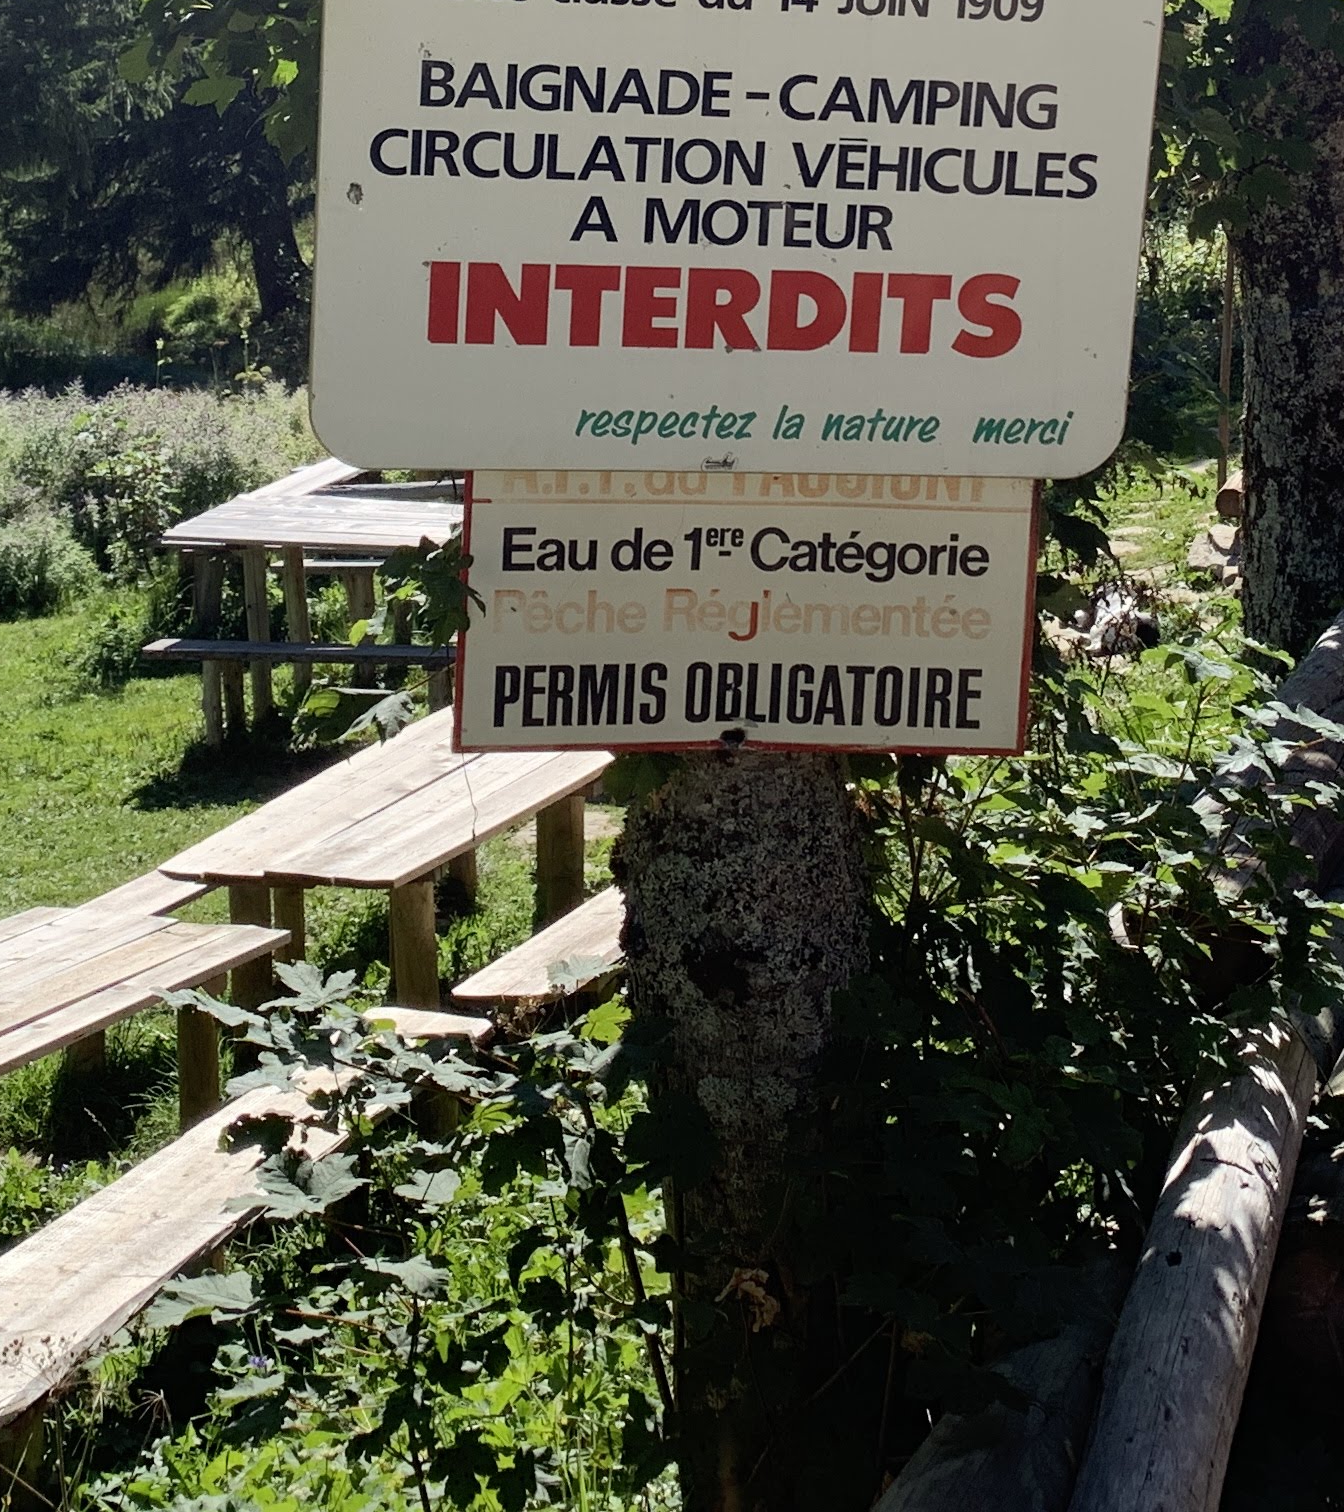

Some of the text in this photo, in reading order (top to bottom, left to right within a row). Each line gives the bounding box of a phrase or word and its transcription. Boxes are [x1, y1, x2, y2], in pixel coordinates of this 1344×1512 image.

[369, 127, 766, 187] CIRCULATION
[569, 195, 893, 251] A MOTEUR
[427, 260, 1022, 359] INTERDITS
[575, 404, 1074, 446] respectez la nature merci
[501, 526, 598, 572] Eau
[610, 526, 674, 572] de
[750, 526, 990, 583] Catégorie
[493, 587, 992, 643] Pêche Réglementée
[493, 661, 983, 730] PERMIS OBLIGATOIRE
